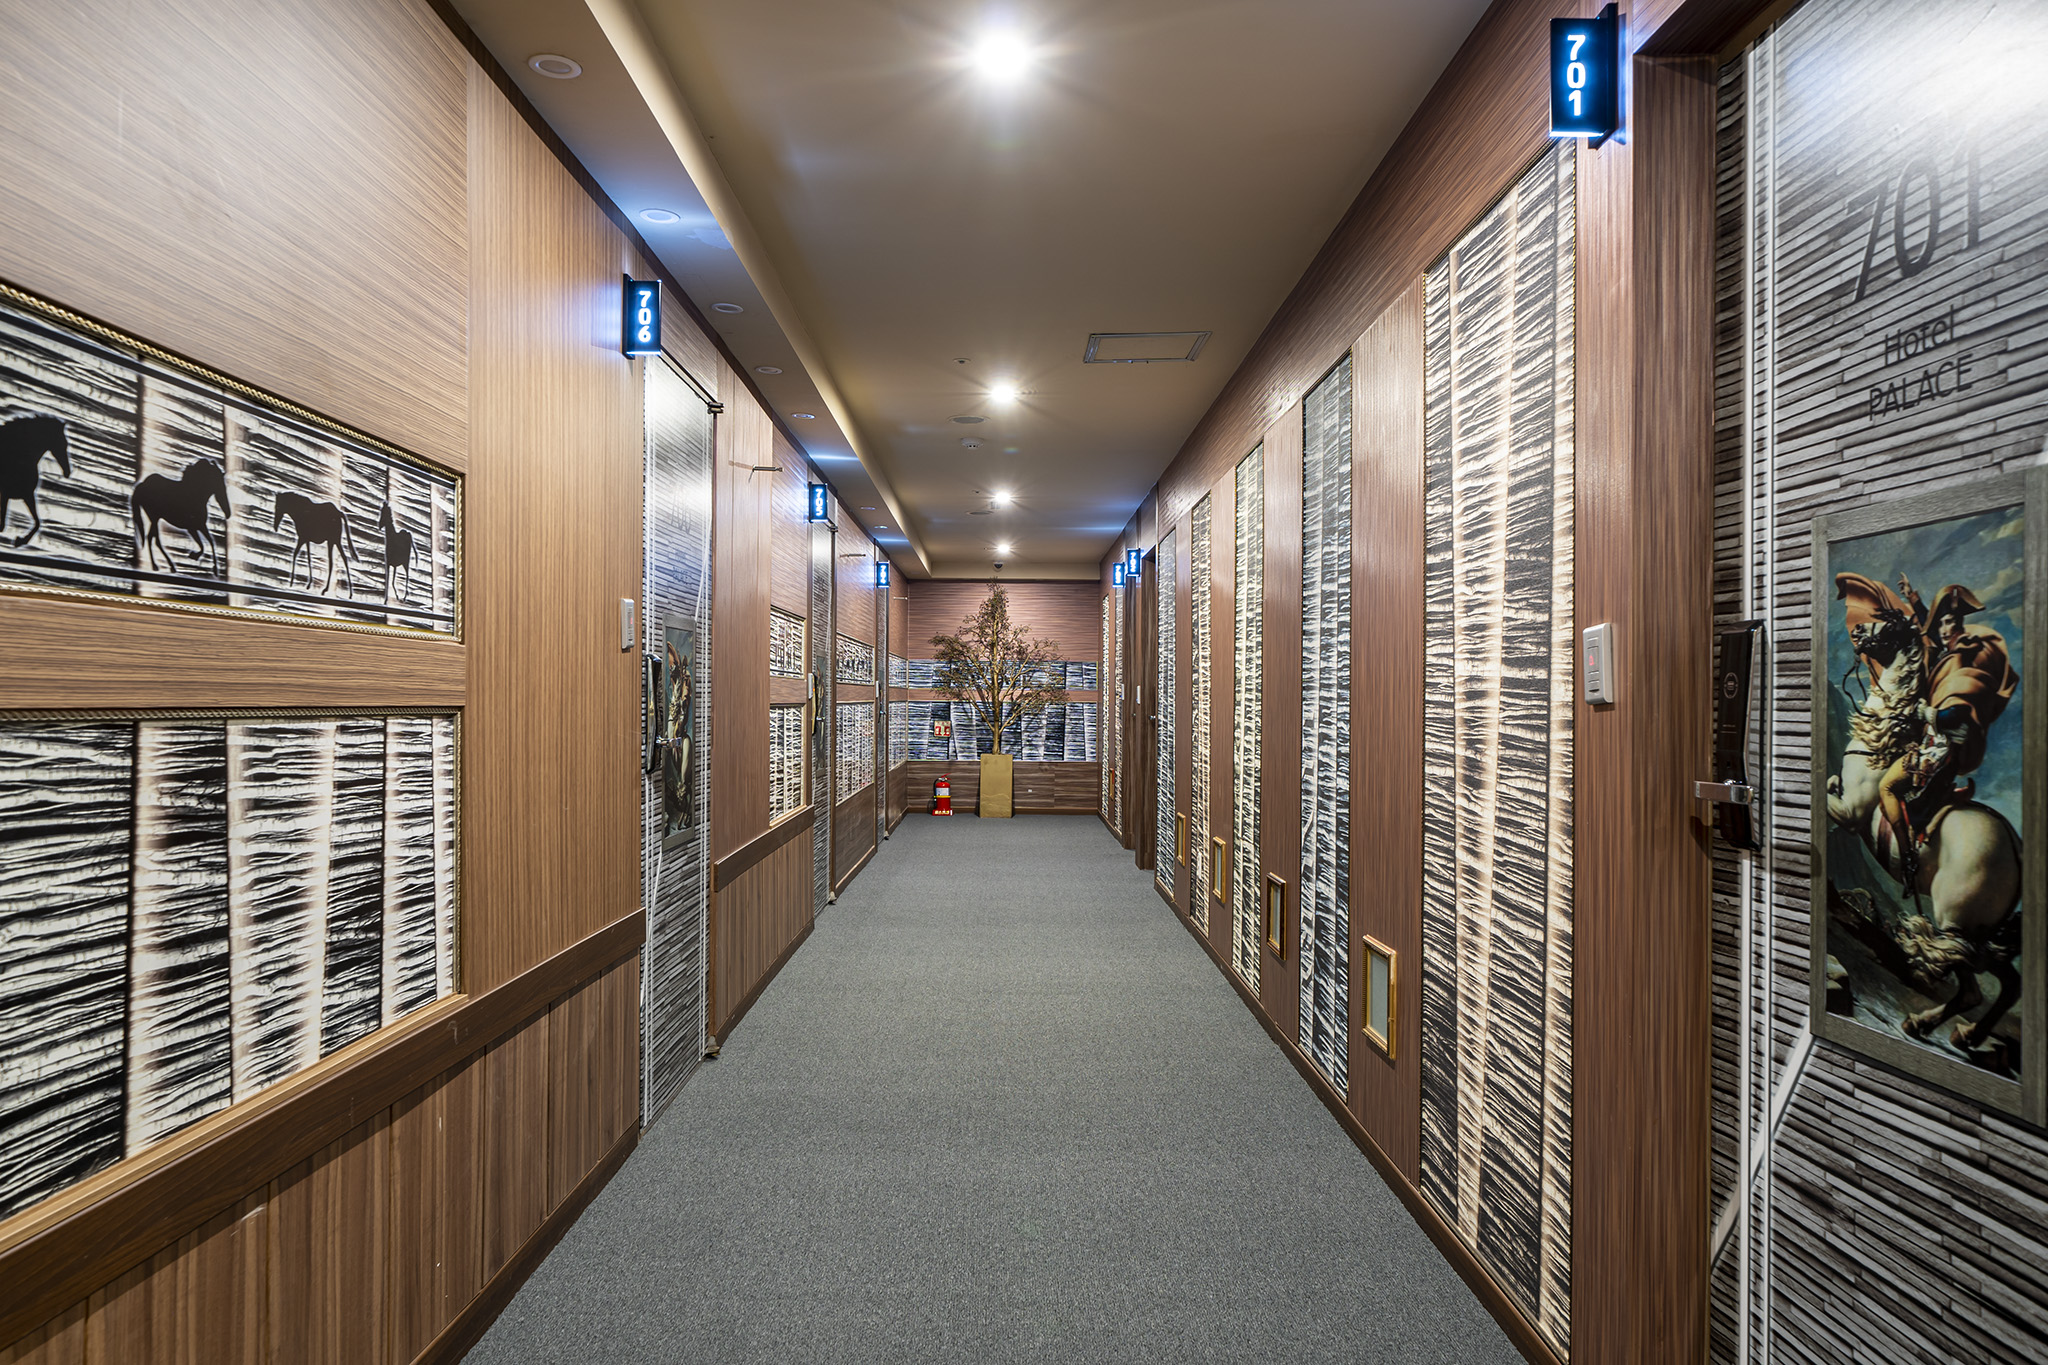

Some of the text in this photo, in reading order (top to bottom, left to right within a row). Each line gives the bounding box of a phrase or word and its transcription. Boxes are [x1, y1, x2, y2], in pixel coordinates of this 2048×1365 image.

[1567, 34, 1586, 116] 701
[1846, 130, 1980, 300] 701
[638, 290, 651, 342] 706
[1884, 304, 1955, 367] Hotel
[1869, 353, 1974, 422] PALACE
[815, 488, 823, 516] 705
